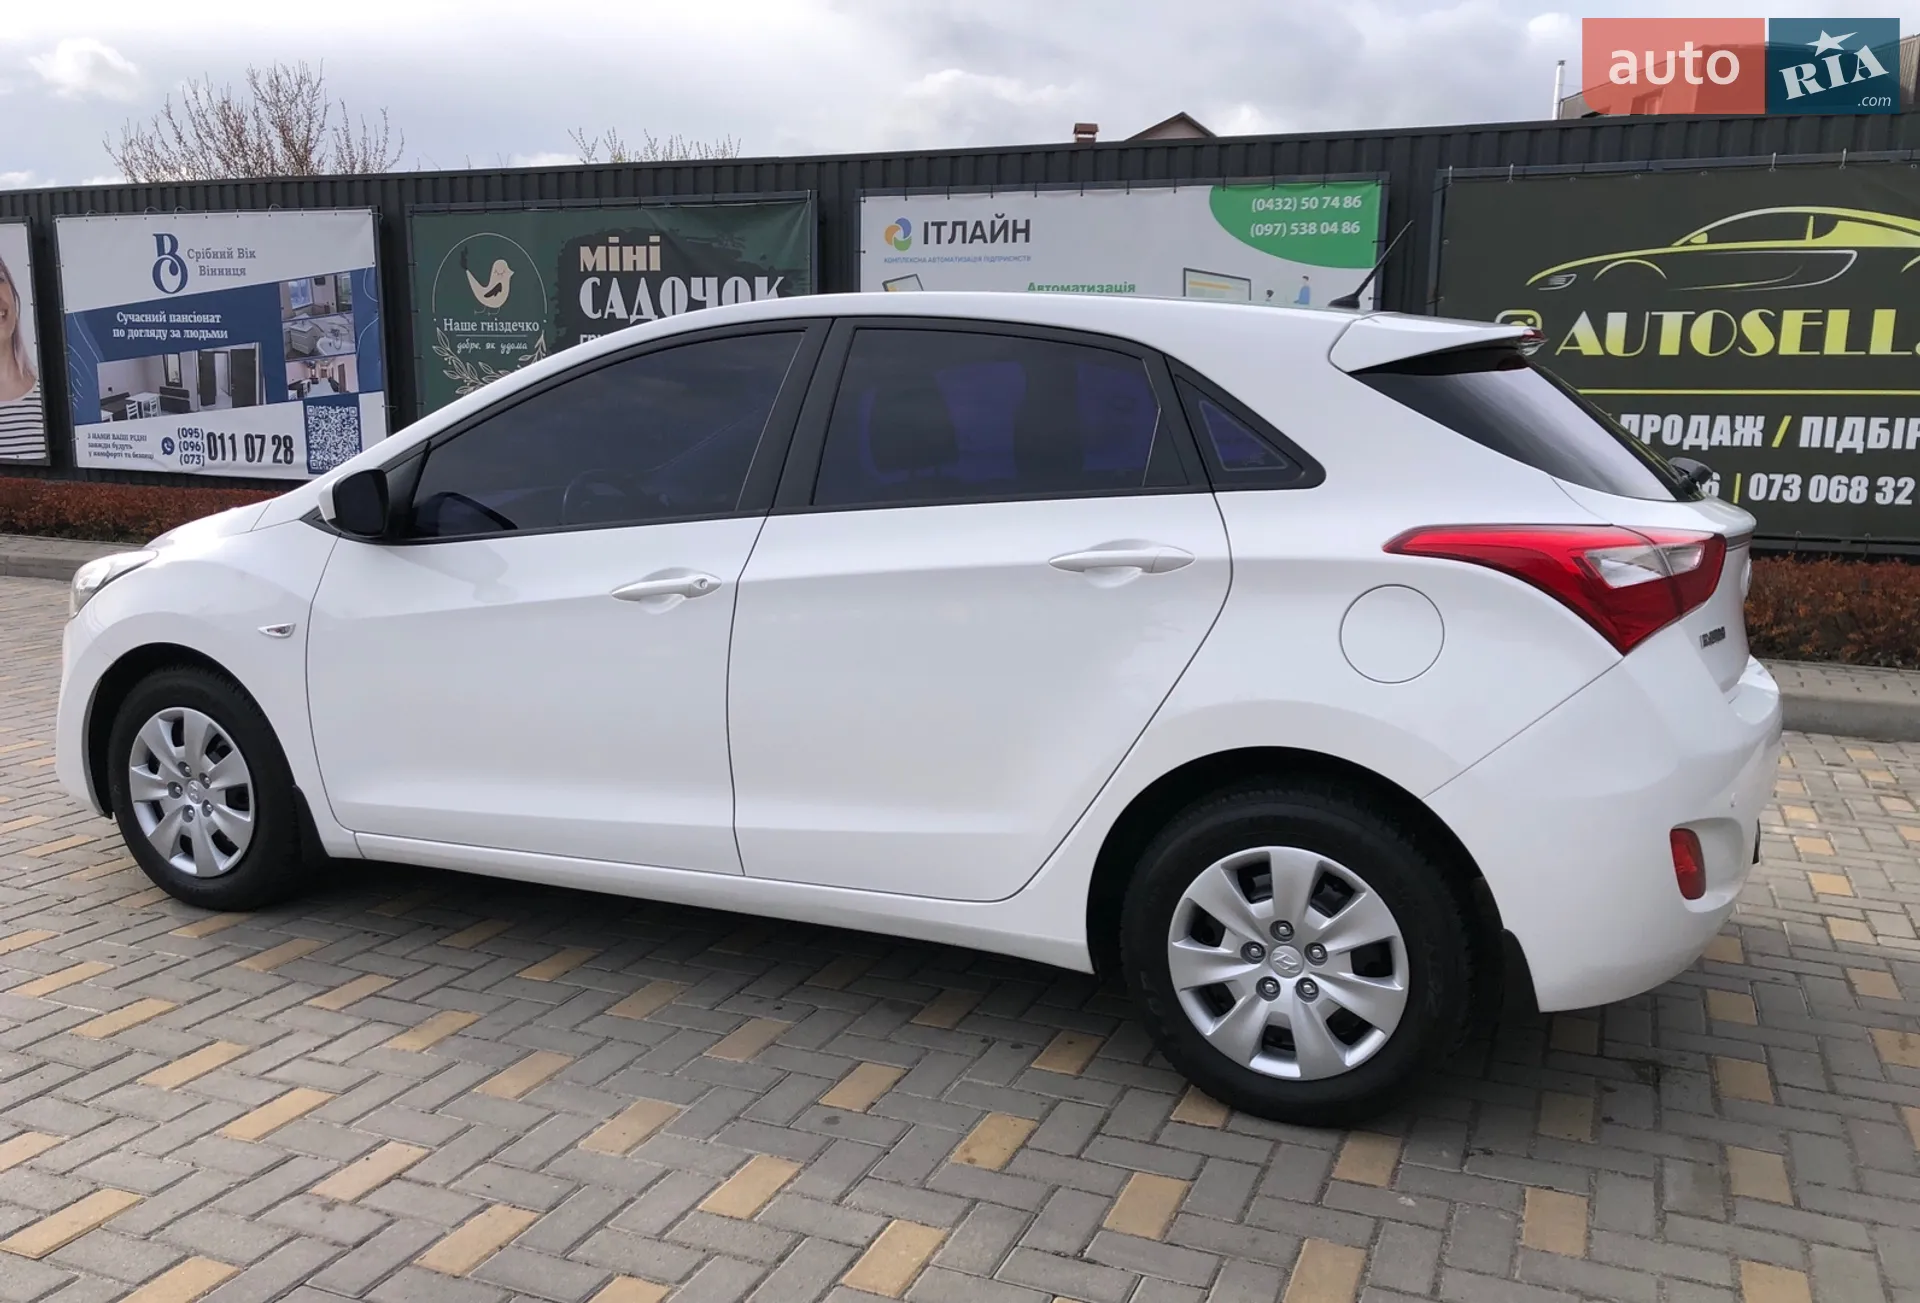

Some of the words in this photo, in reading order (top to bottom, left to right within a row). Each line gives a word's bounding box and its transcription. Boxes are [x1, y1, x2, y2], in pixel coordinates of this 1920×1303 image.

[1251, 197, 1298, 213] (0432)
[1300, 196, 1319, 210] 50
[1322, 195, 1340, 209] 74
[1343, 195, 1362, 209] 86
[923, 213, 1031, 245] ІТЛАЙН
[1250, 222, 1287, 238] (097)
[1290, 221, 1317, 235] 538
[1320, 221, 1339, 234] 04
[1341, 220, 1361, 234] 86
[187, 246, 234, 262] Срібний
[237, 246, 257, 259] Вік
[580, 235, 661, 272] міні
[198, 265, 247, 277] Вінниця
[1027, 281, 1136, 294] Автоматизація
[117, 311, 167, 325] Сучасний
[169, 311, 222, 324] пансіонат
[443, 318, 477, 331] Наше
[480, 317, 540, 333] гніздечко
[112, 328, 125, 338] по
[127, 328, 168, 341] догляду
[169, 329, 181, 338] за
[183, 329, 228, 341] людьми
[177, 427, 204, 440] (095)
[179, 440, 205, 453] (096)
[206, 431, 237, 461] 011
[244, 433, 266, 463] 07
[271, 434, 295, 465] 28
[179, 453, 206, 467] (073)
[1749, 472, 1803, 502] 073
[1808, 474, 1869, 504] 068
[1875, 475, 1916, 505] 32
